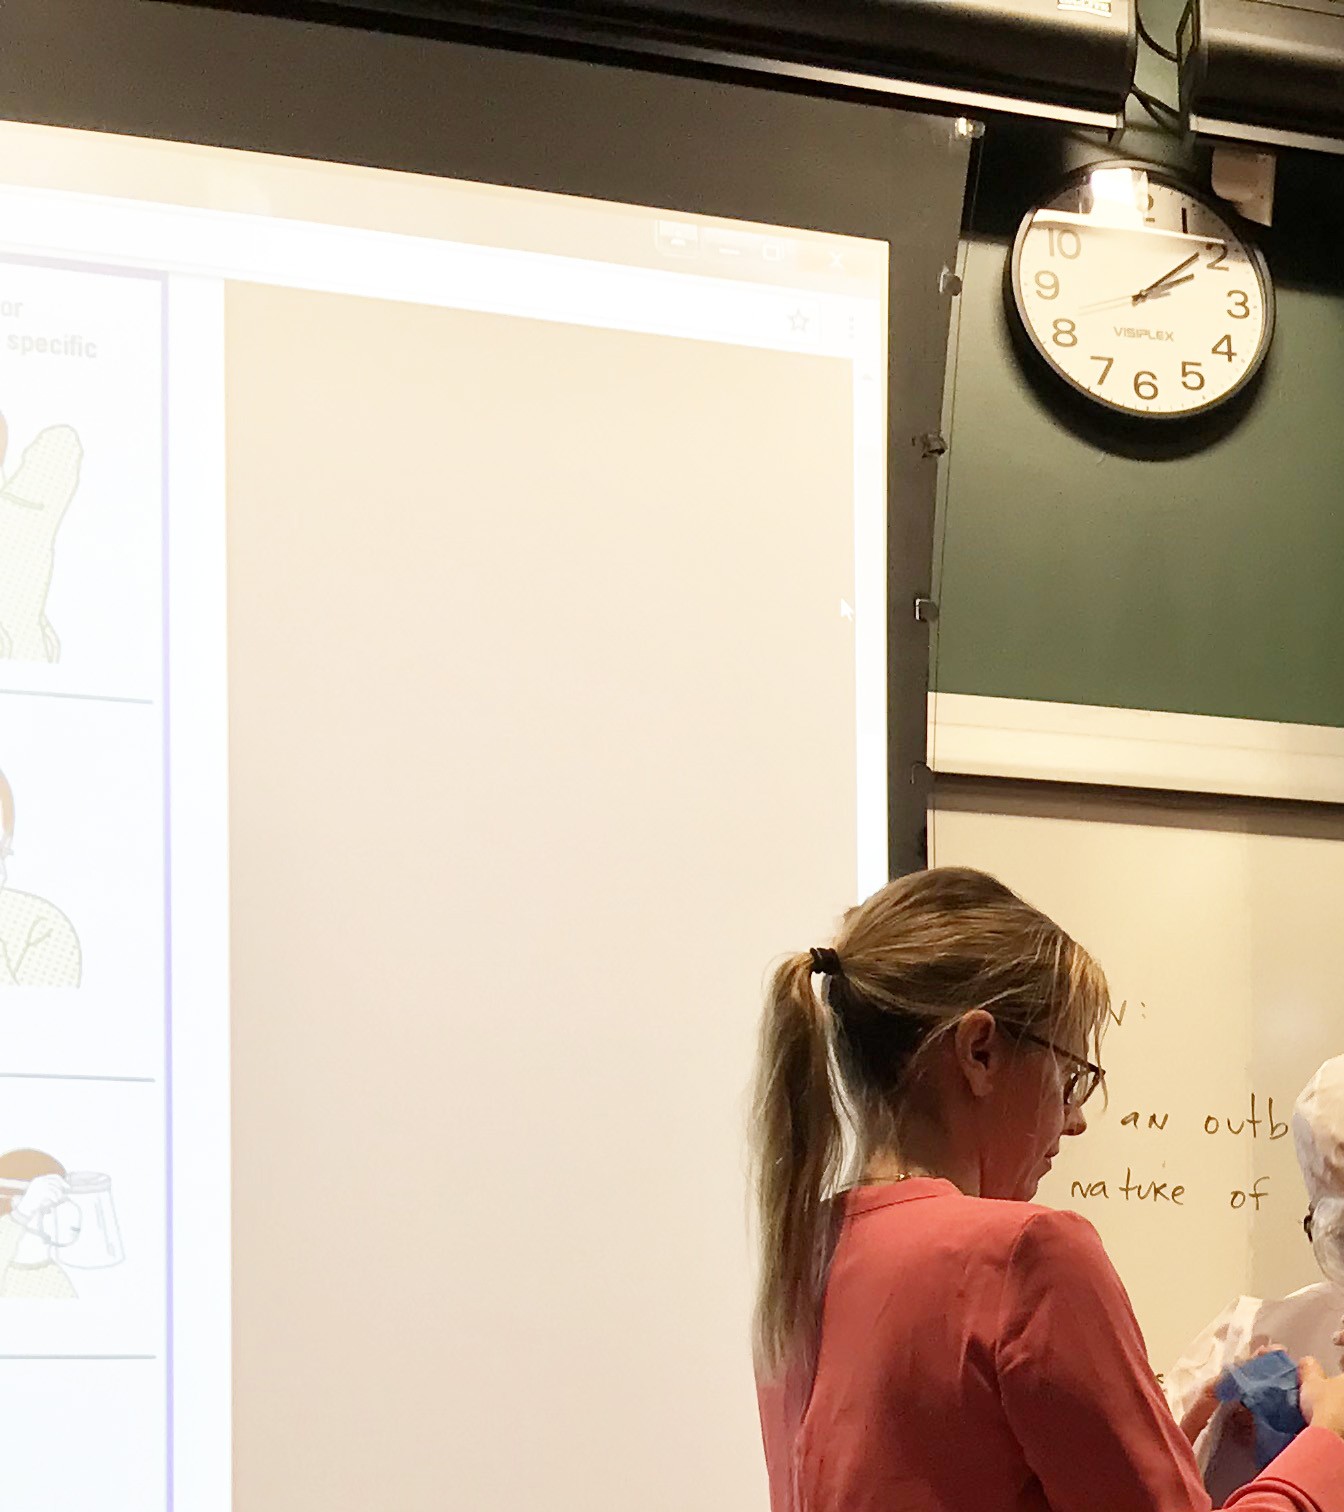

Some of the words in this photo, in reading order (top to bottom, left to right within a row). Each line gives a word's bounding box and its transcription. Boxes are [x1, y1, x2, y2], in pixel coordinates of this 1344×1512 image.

[1048, 229, 1082, 260] 10
[1205, 243, 1230, 271] 2
[1034, 270, 1060, 300] 9
[1226, 289, 1250, 319] 3
[7, 334, 98, 358] specific
[1052, 318, 1078, 347] 8
[1211, 334, 1237, 362] 4
[1090, 355, 1114, 385] 7
[1133, 370, 1159, 400] 6
[1181, 361, 1205, 390] 5
[1071, 1167, 1185, 1206] nature
[1230, 1176, 1271, 1211] of
